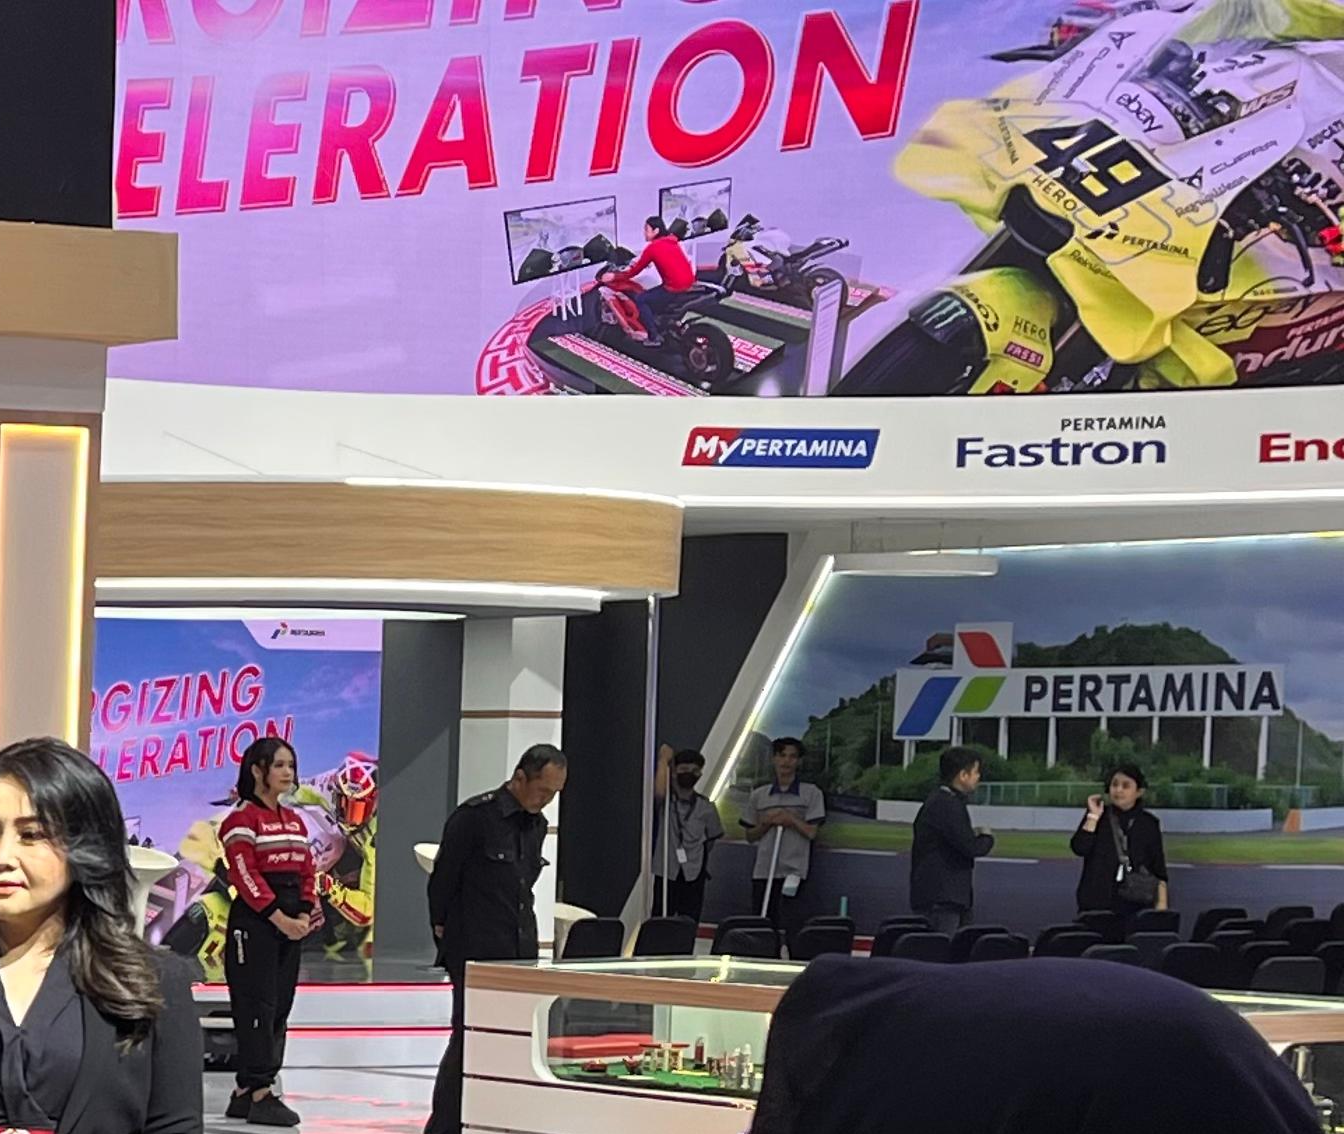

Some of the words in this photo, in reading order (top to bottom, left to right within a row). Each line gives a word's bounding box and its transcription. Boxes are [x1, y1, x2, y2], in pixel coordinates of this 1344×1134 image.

[1116, 93, 1163, 133] ebay
[1023, 118, 1173, 217] 49
[1032, 174, 1077, 212] HERO
[1122, 234, 1190, 258] PERTAMINA
[1013, 316, 1047, 340] HERO
[1061, 416, 1166, 431] PERTAMINA
[956, 437, 1166, 468] Fastron
[1024, 671, 1281, 712] PERTAMINA
